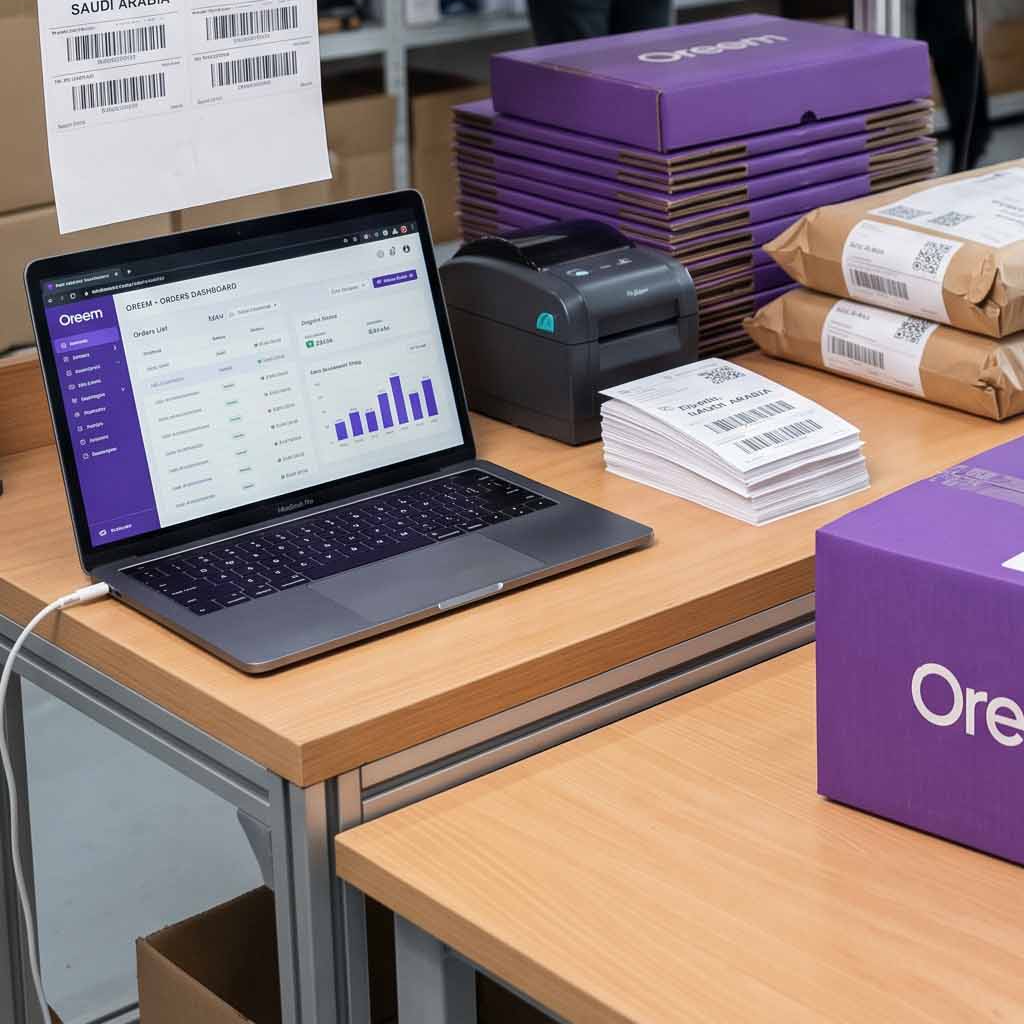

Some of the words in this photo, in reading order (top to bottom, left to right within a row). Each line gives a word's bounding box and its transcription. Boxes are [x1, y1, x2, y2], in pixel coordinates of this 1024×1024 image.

[638, 34, 788, 63] Oreem
[126, 299, 153, 312] OREEM
[160, 292, 190, 305] ORDERS
[191, 283, 237, 298] DASHBOARD
[59, 309, 103, 326] Oreem
